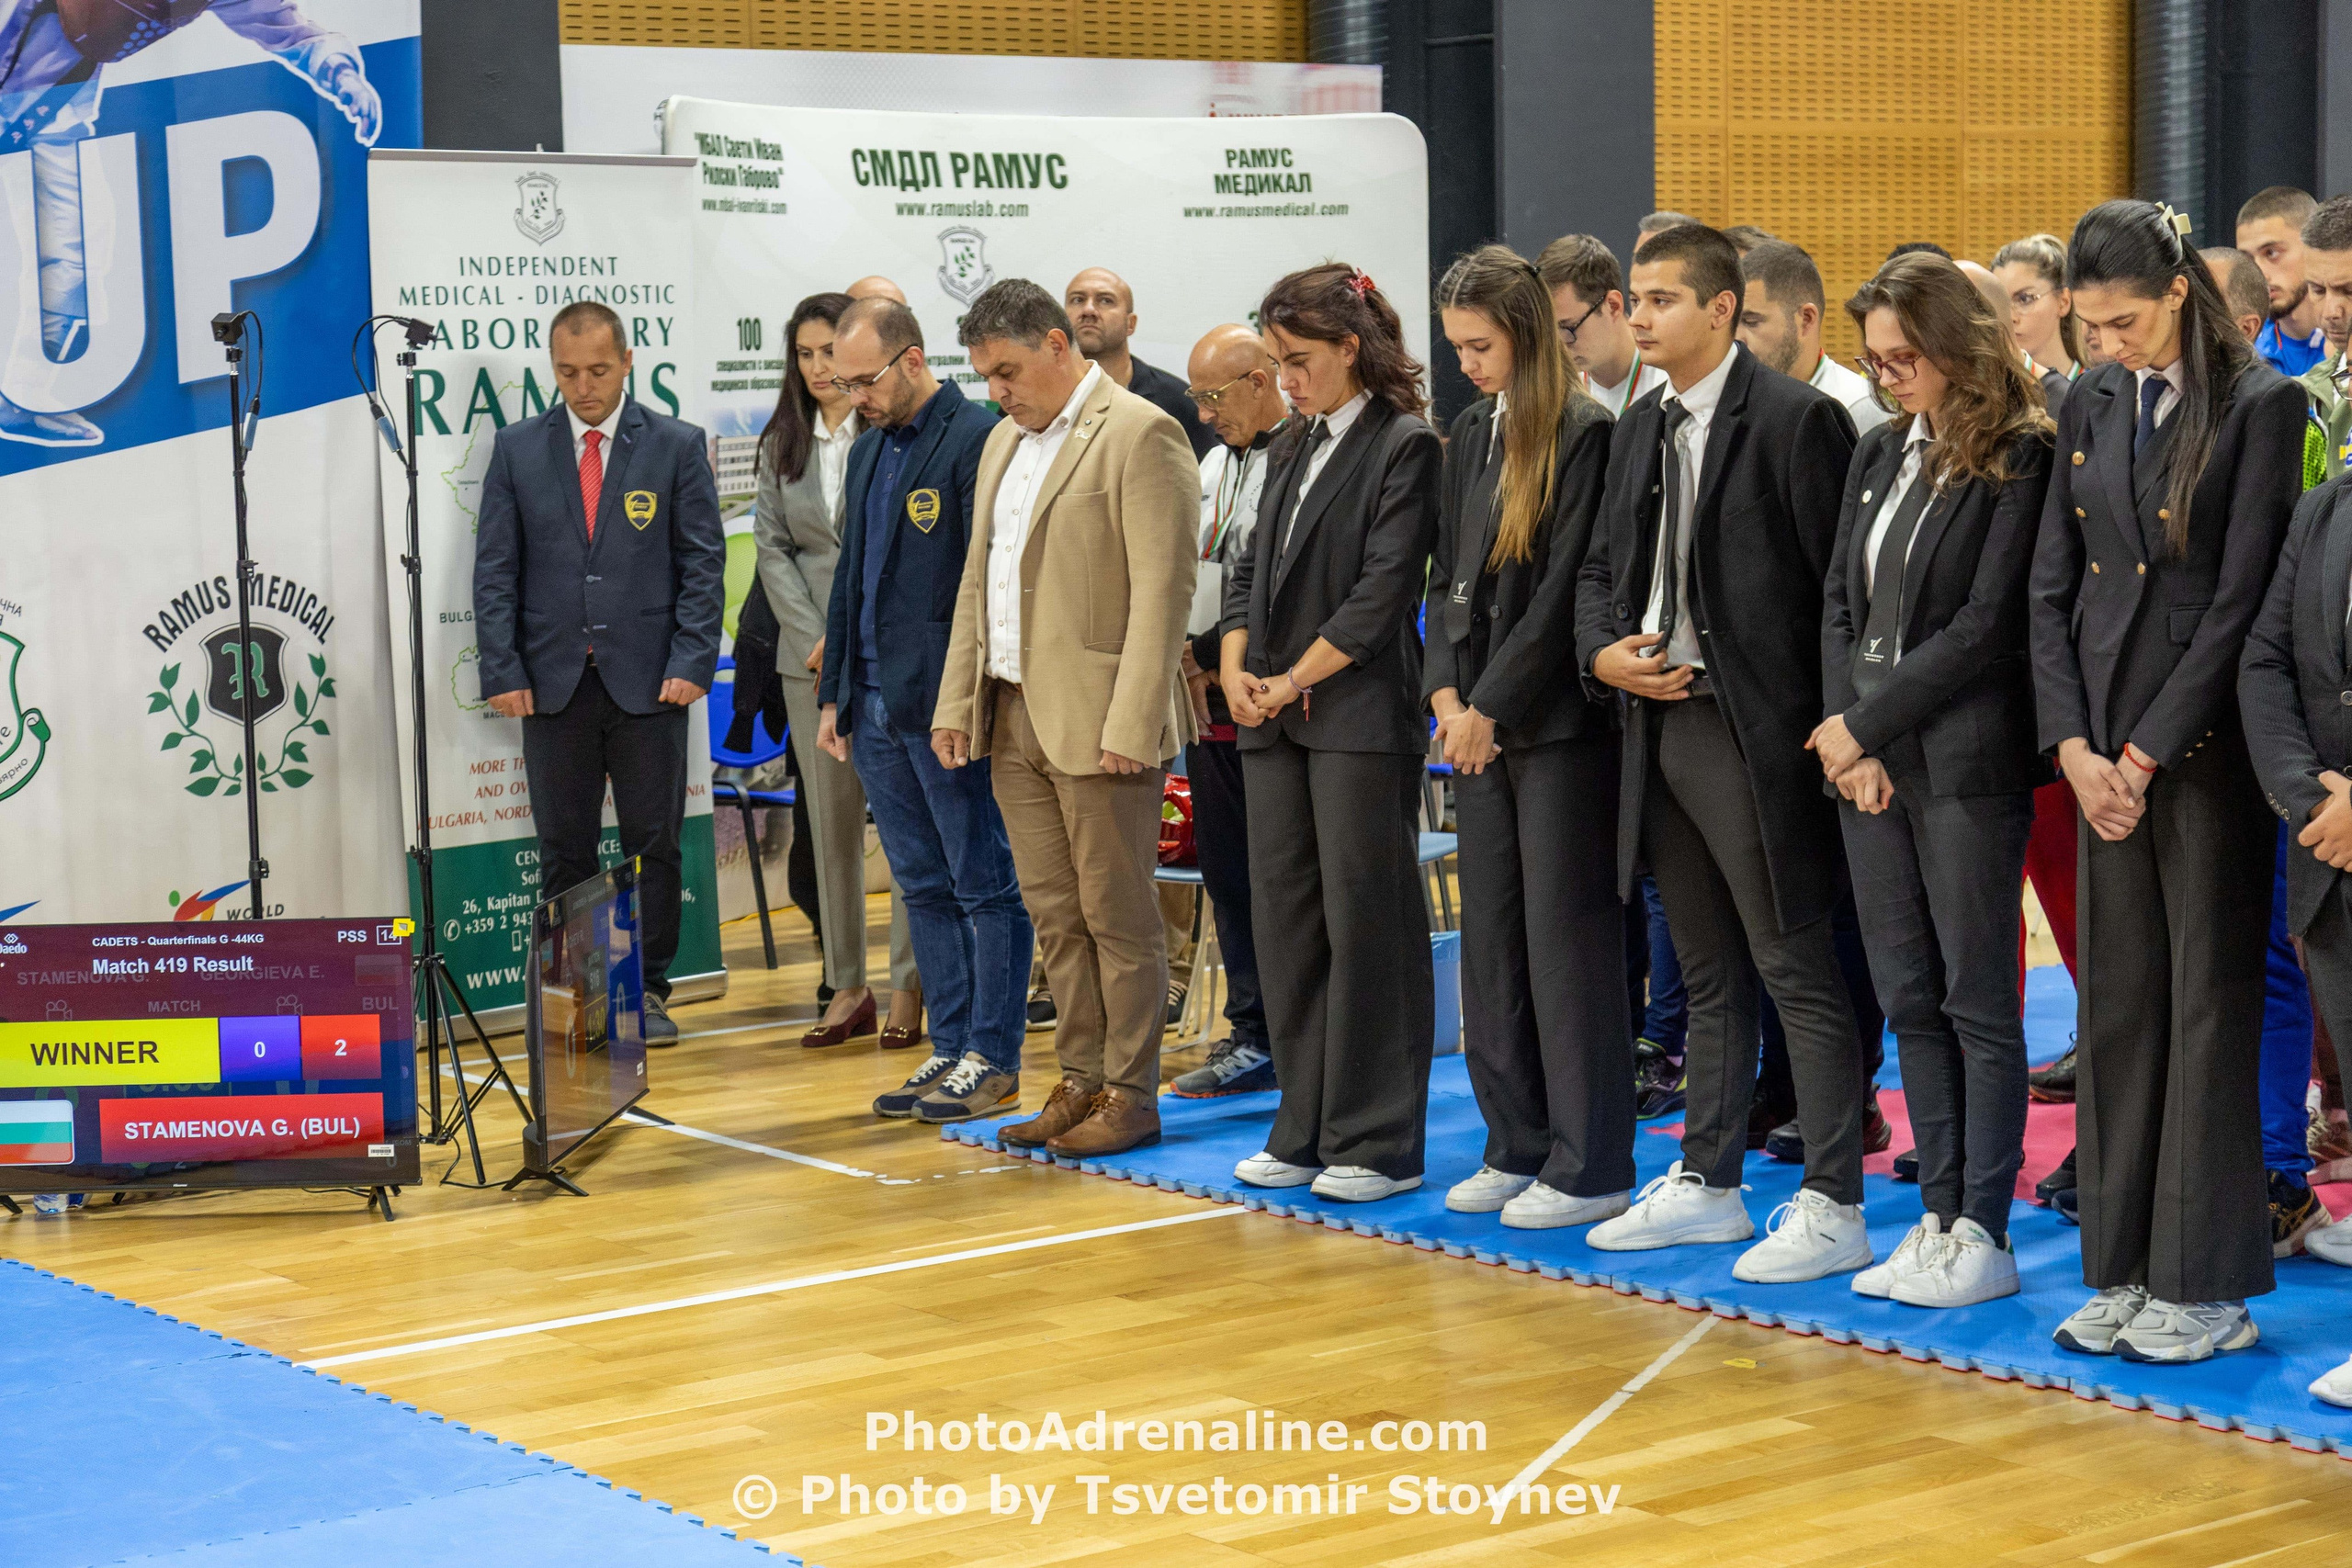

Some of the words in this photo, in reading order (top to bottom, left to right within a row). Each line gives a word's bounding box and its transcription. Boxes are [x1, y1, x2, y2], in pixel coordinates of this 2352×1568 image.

[1225, 147, 1295, 168] РАМУС
[851, 147, 944, 192] СМДЛ
[948, 151, 1069, 189] РАМУС
[1213, 172, 1313, 196] МЕДИКАЛ
[895, 199, 1030, 218] www.ramuslab.com
[1183, 201, 1350, 218] www.ramusmedical.com
[458, 256, 618, 276] INDEPENDENT
[399, 285, 505, 307] MEDICAL
[536, 284, 676, 305] DIAGNOSTIC
[412, 317, 675, 351] ABORRY
[737, 318, 762, 351] 100
[413, 361, 681, 436] RAMS
[142, 576, 231, 653] RAMUS
[248, 573, 335, 645] MEDICAL
[439, 610, 473, 623] BULG
[469, 759, 506, 774] MORE
[474, 784, 504, 799] AND
[417, 811, 487, 830] ULGARIA,
[515, 851, 540, 866] CEN
[521, 870, 542, 886] Sofi
[226, 904, 285, 920] WOLD
[462, 898, 481, 915] 26,
[487, 892, 531, 913] Kapitan
[464, 917, 494, 934] +359
[499, 915, 507, 930] 2
[92, 937, 138, 946] CADETS
[147, 935, 217, 946] Quarterfinals
[220, 934, 229, 943] G
[231, 933, 265, 943] -44KG
[337, 931, 368, 942] PSS
[93, 958, 150, 975] Match
[154, 957, 188, 973] 419
[193, 955, 254, 972] Result
[148, 1000, 200, 1012] MATCH
[362, 997, 399, 1010] BUL
[30, 1041, 159, 1066] WINNER
[254, 1042, 266, 1058] 0
[334, 1040, 347, 1056] 2
[124, 1119, 266, 1140] STAMENOVA
[271, 1119, 294, 1136] G.
[300, 1116, 360, 1140] (BUL)
